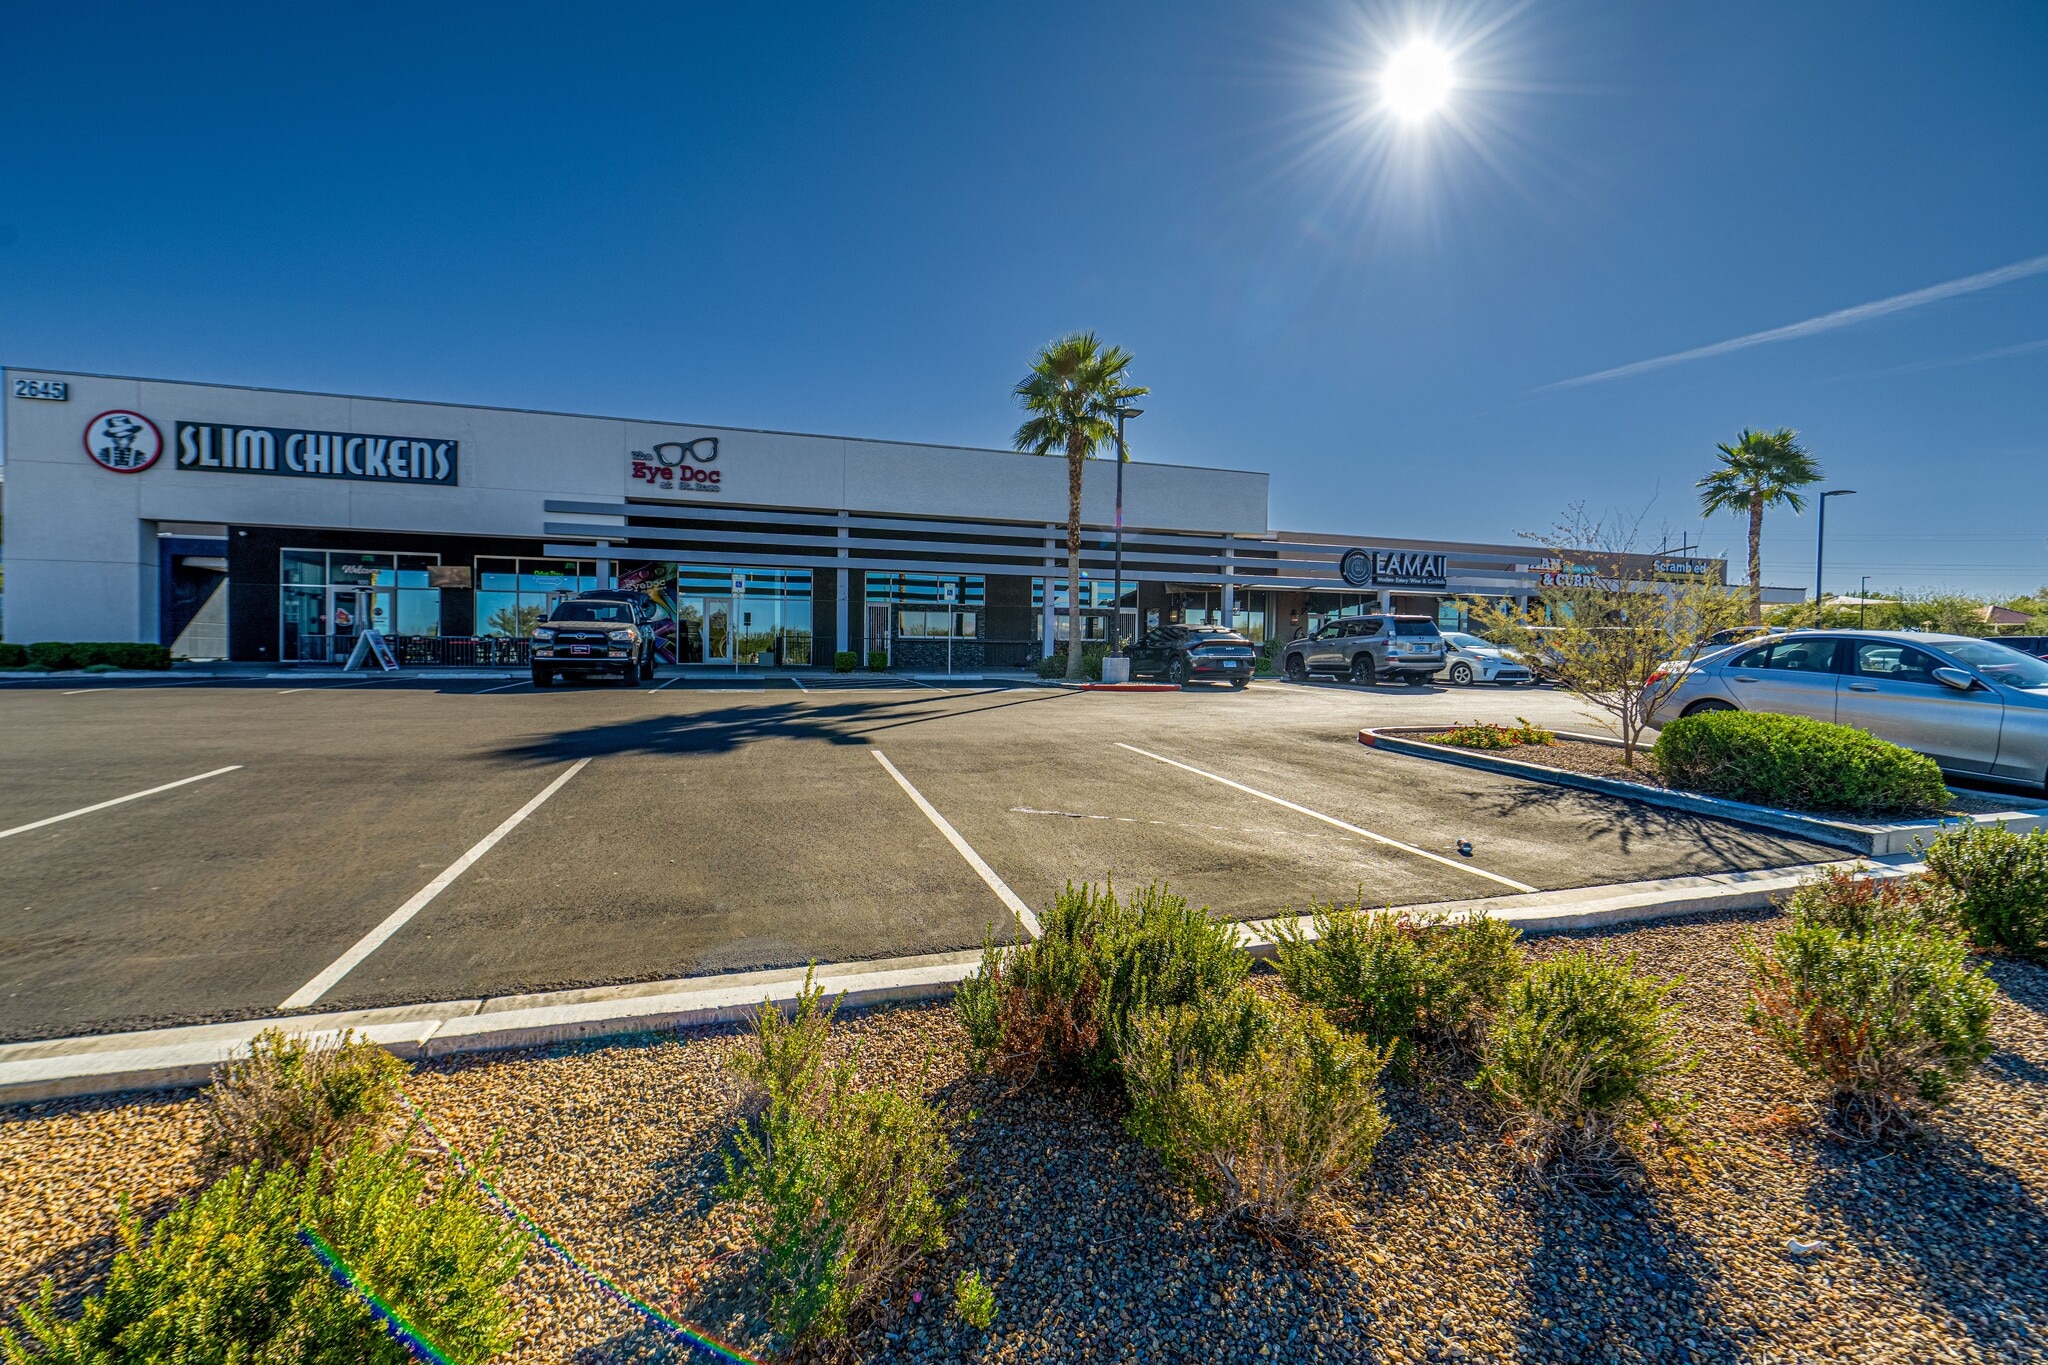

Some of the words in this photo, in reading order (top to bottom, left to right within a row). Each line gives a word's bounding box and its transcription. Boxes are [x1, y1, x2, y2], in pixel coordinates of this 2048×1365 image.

[15, 380, 65, 398] 2645
[180, 425, 277, 470] SLIM
[285, 433, 450, 480] CHICKENS
[632, 461, 673, 484] Eye
[680, 465, 721, 484] Doc
[1543, 573, 1553, 586] &
